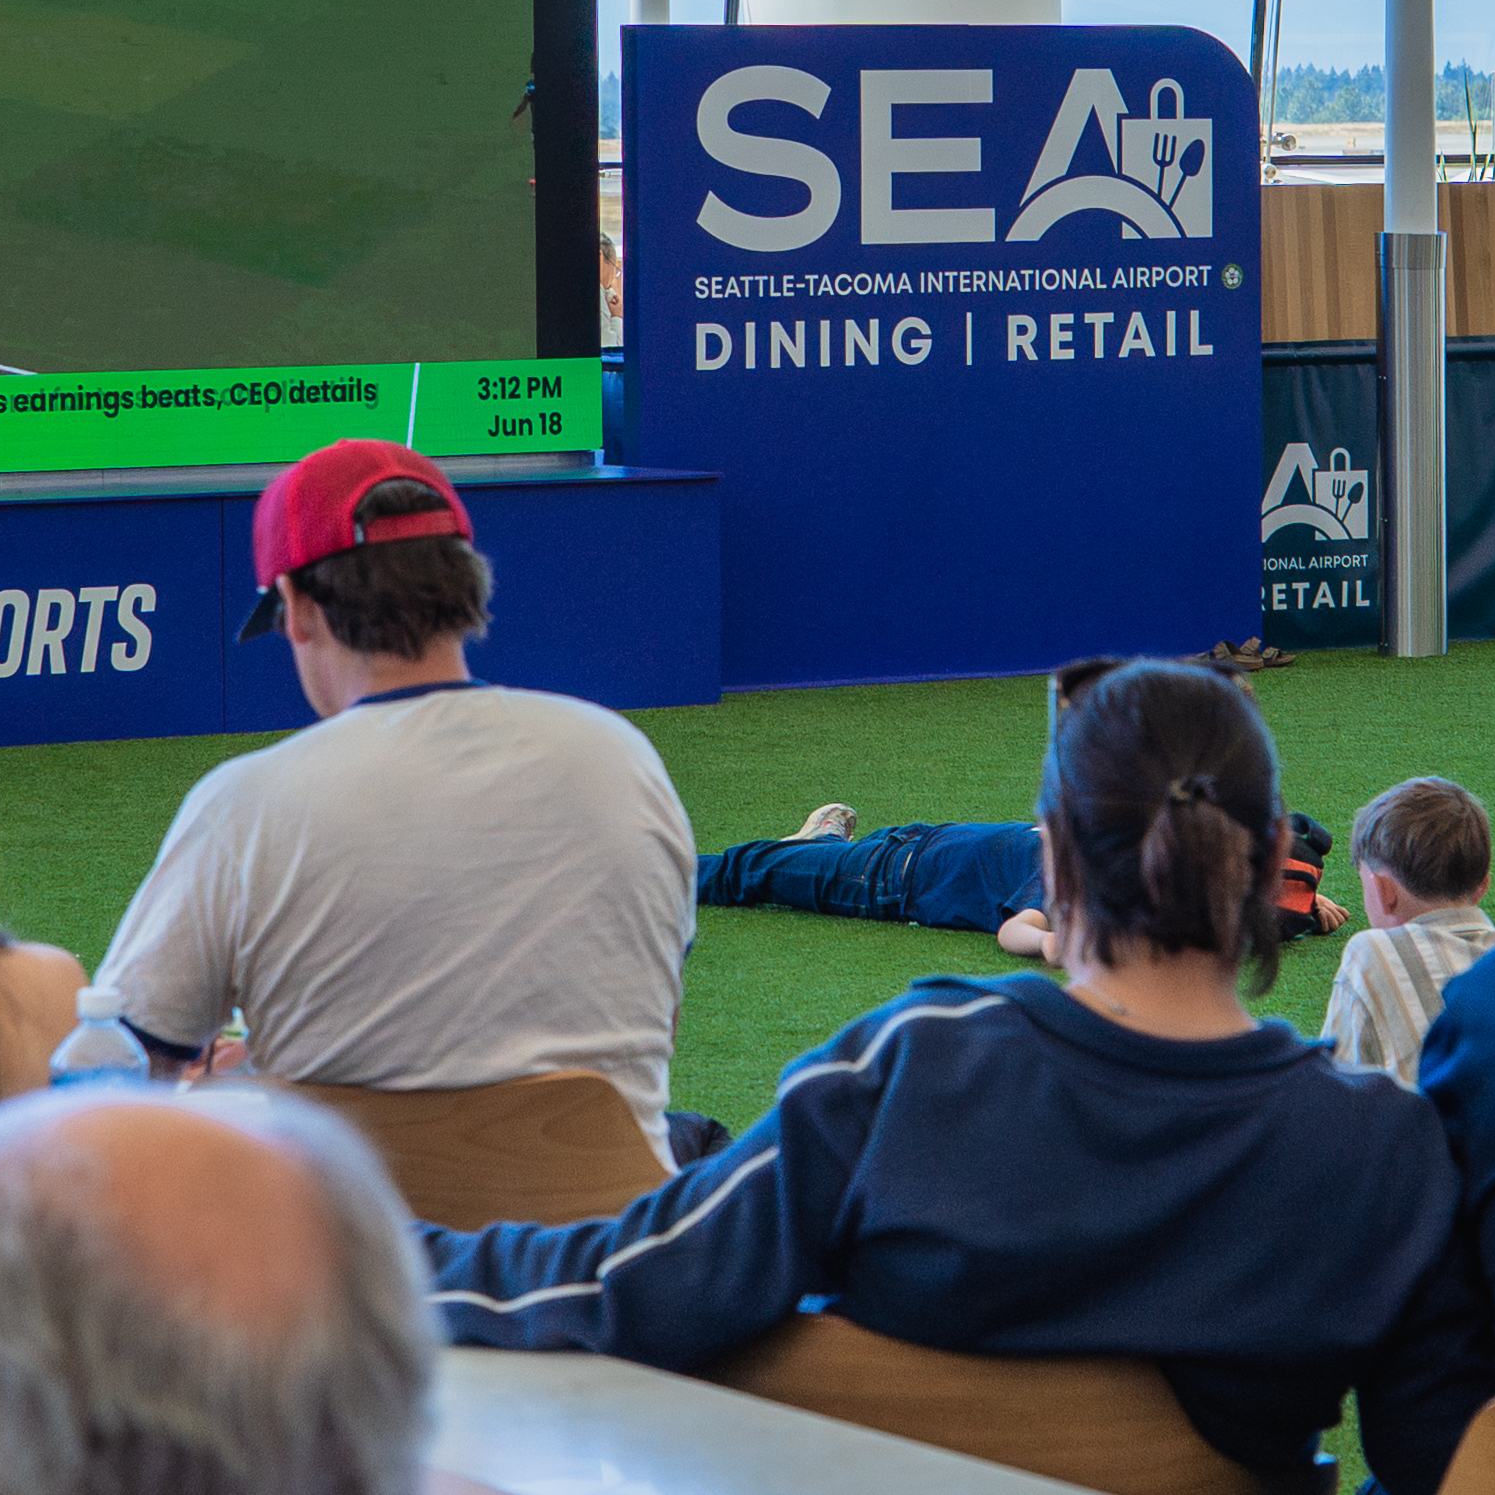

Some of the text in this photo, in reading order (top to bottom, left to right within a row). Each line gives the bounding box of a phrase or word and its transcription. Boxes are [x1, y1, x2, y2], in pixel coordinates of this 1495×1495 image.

[695, 64, 1190, 253] SEA
[695, 265, 1212, 299] SEATTLE-TACOMA INTERNATIONAL AIRPORT
[695, 316, 933, 371] DINING
[1007, 309, 1214, 362] RETAIL
[13, 385, 134, 418] earnings
[141, 384, 222, 411] beats,
[229, 381, 283, 406] CEO
[288, 376, 377, 405] details
[477, 375, 562, 400] 3:12 PM
[488, 411, 563, 437] Jun 18
[1308, 554, 1369, 570] AIRPORT
[1261, 579, 1371, 612] ETAIL
